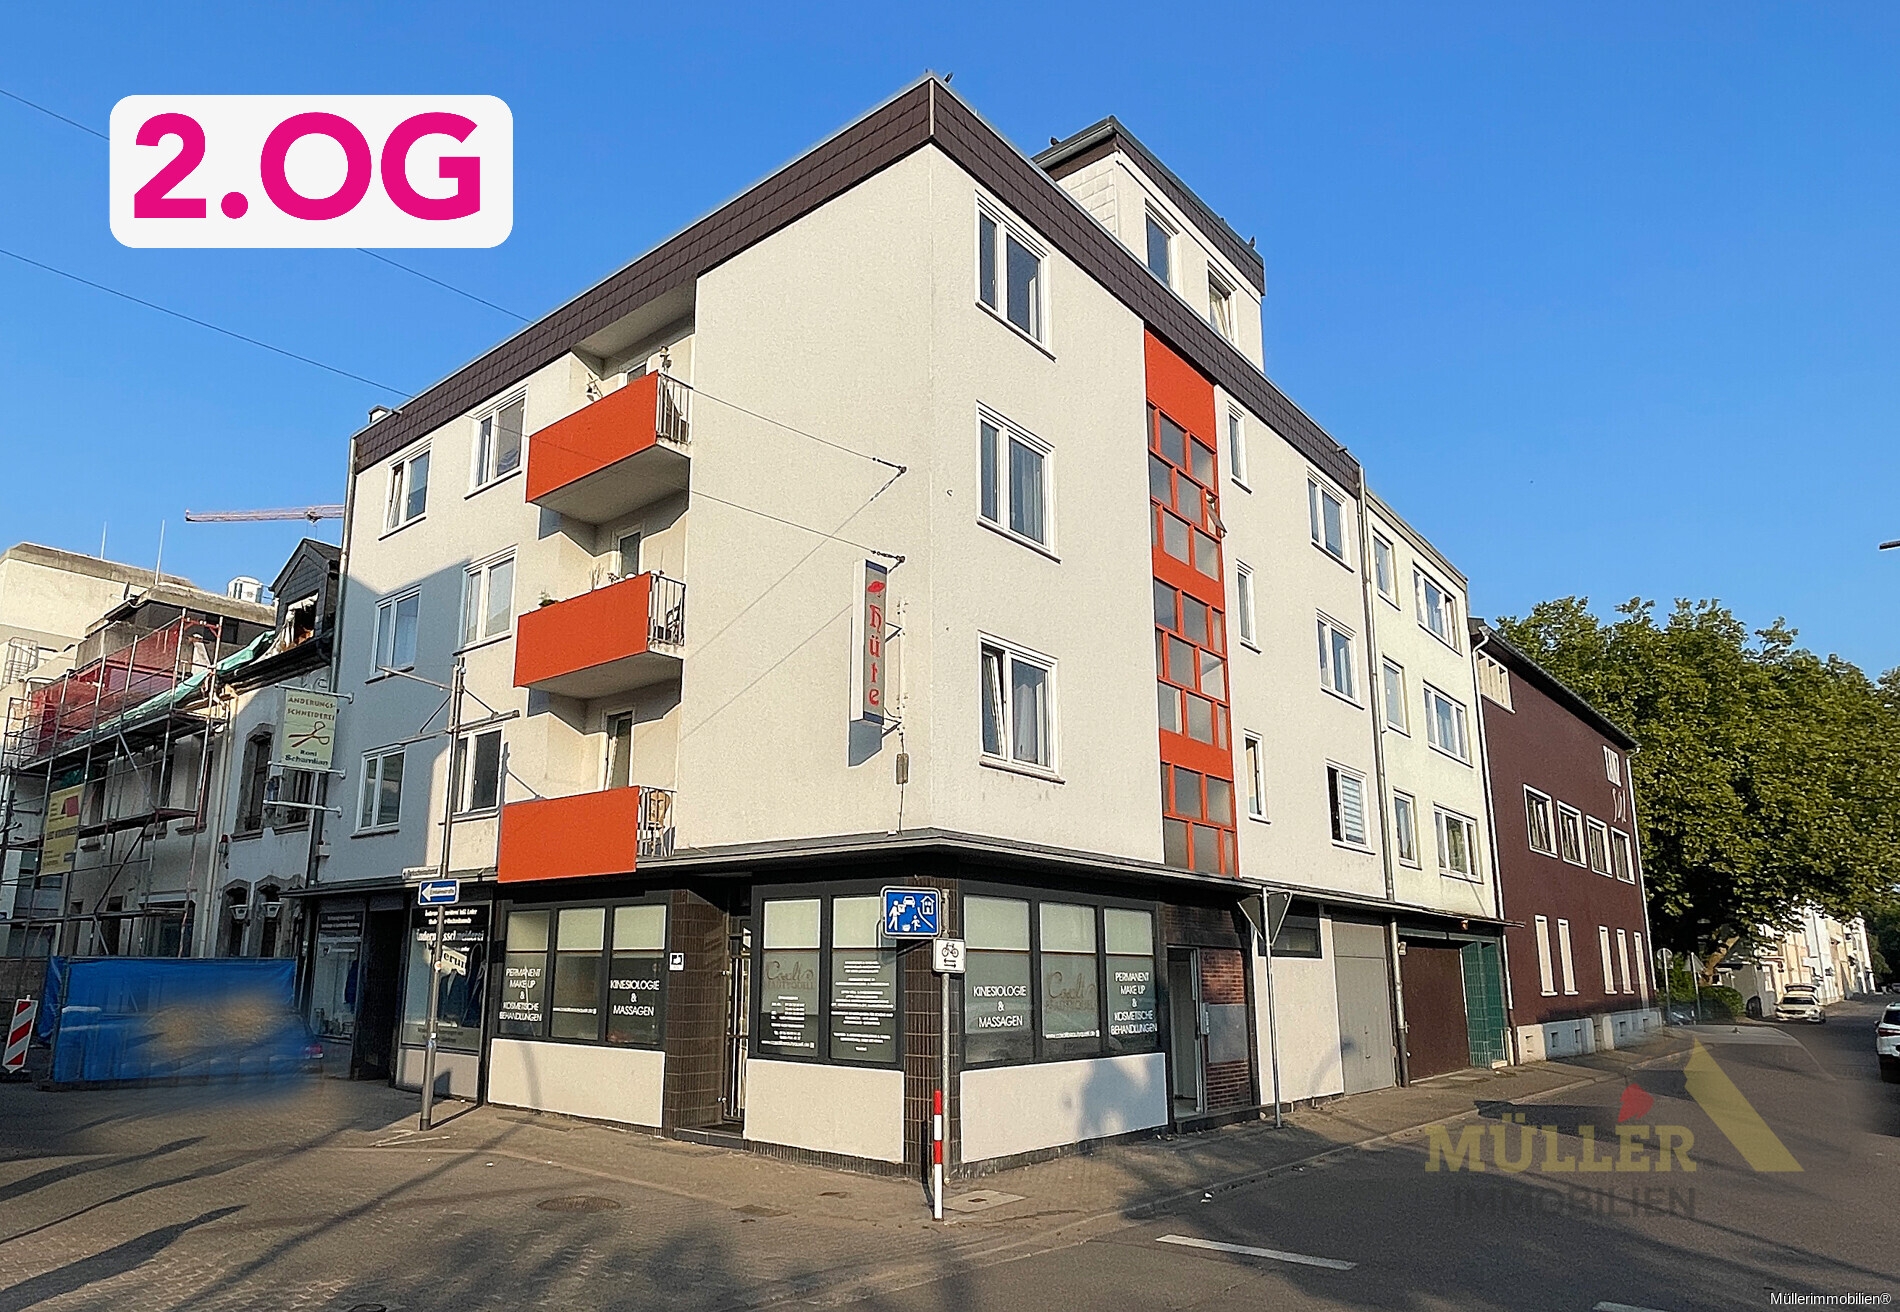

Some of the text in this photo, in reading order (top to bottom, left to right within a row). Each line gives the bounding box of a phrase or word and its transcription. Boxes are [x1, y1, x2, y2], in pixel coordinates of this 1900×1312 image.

[287, 708, 335, 721] SCHNEIDEREI
[505, 968, 541, 977] PERMANENT
[1115, 972, 1149, 982] PERMANENT
[509, 980, 536, 989] MAKE UP
[610, 980, 660, 991] KINESIOLOGIE
[973, 985, 1027, 997] KINESIOLOGIE
[1120, 985, 1146, 995] MAKE UP
[630, 993, 638, 1003] &
[1131, 998, 1138, 1008] &
[503, 1002, 539, 1011] KOSMETISCHE
[613, 1005, 654, 1017] MASSAGEN
[997, 1001, 1005, 1012] &
[499, 1012, 542, 1022] BEHANDLUNGEN
[1114, 1010, 1153, 1021] KOSMETISCHE
[978, 1016, 1023, 1028] MASSAGEN
[1110, 1022, 1158, 1035] BEHANDLUNGEN
